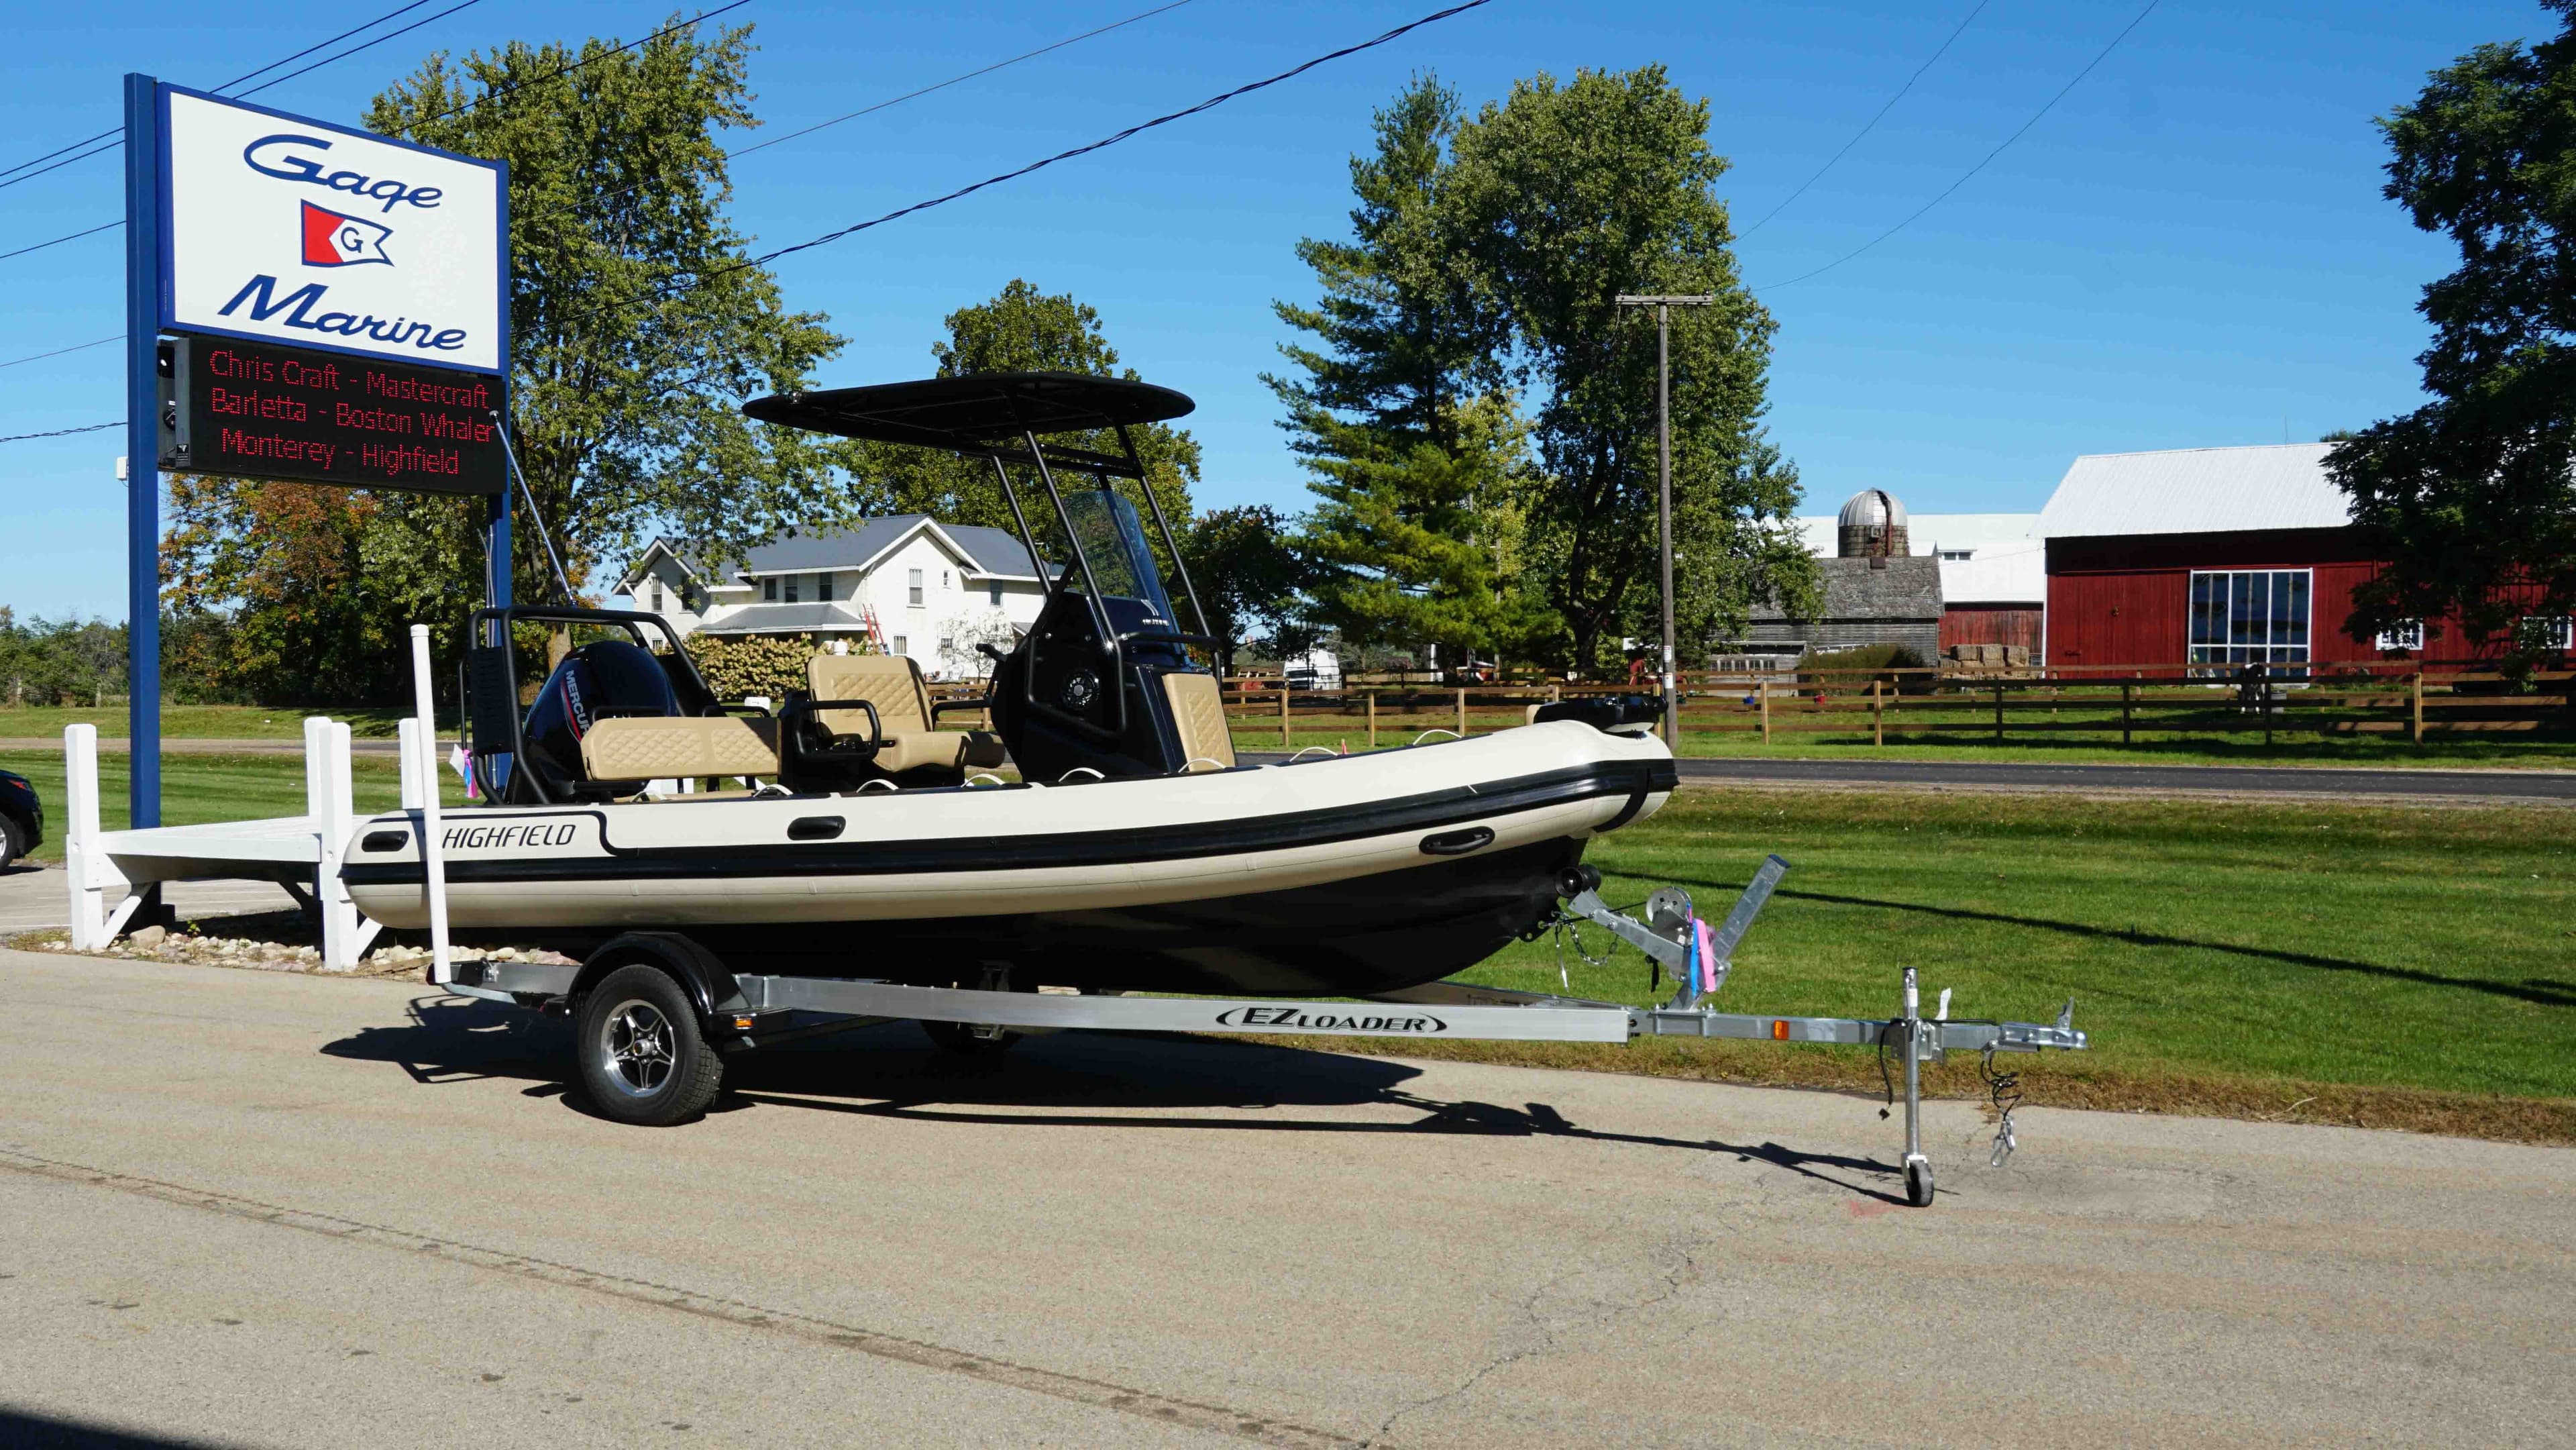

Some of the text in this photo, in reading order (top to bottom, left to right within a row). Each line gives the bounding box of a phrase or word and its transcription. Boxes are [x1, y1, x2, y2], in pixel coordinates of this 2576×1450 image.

[243, 133, 443, 213] Gage
[340, 226, 364, 254] G
[217, 273, 468, 351] Marine
[209, 350, 274, 382] Chris
[281, 360, 341, 391] Craft
[366, 370, 490, 409] Mastercraft
[211, 387, 307, 423] Barletta
[336, 403, 412, 434] Boston
[419, 412, 496, 443] Whaler
[221, 427, 336, 470] Monterey
[362, 443, 460, 477] Highfield
[566, 670, 590, 735] MERCUR
[441, 824, 576, 849] HIGHFIELD
